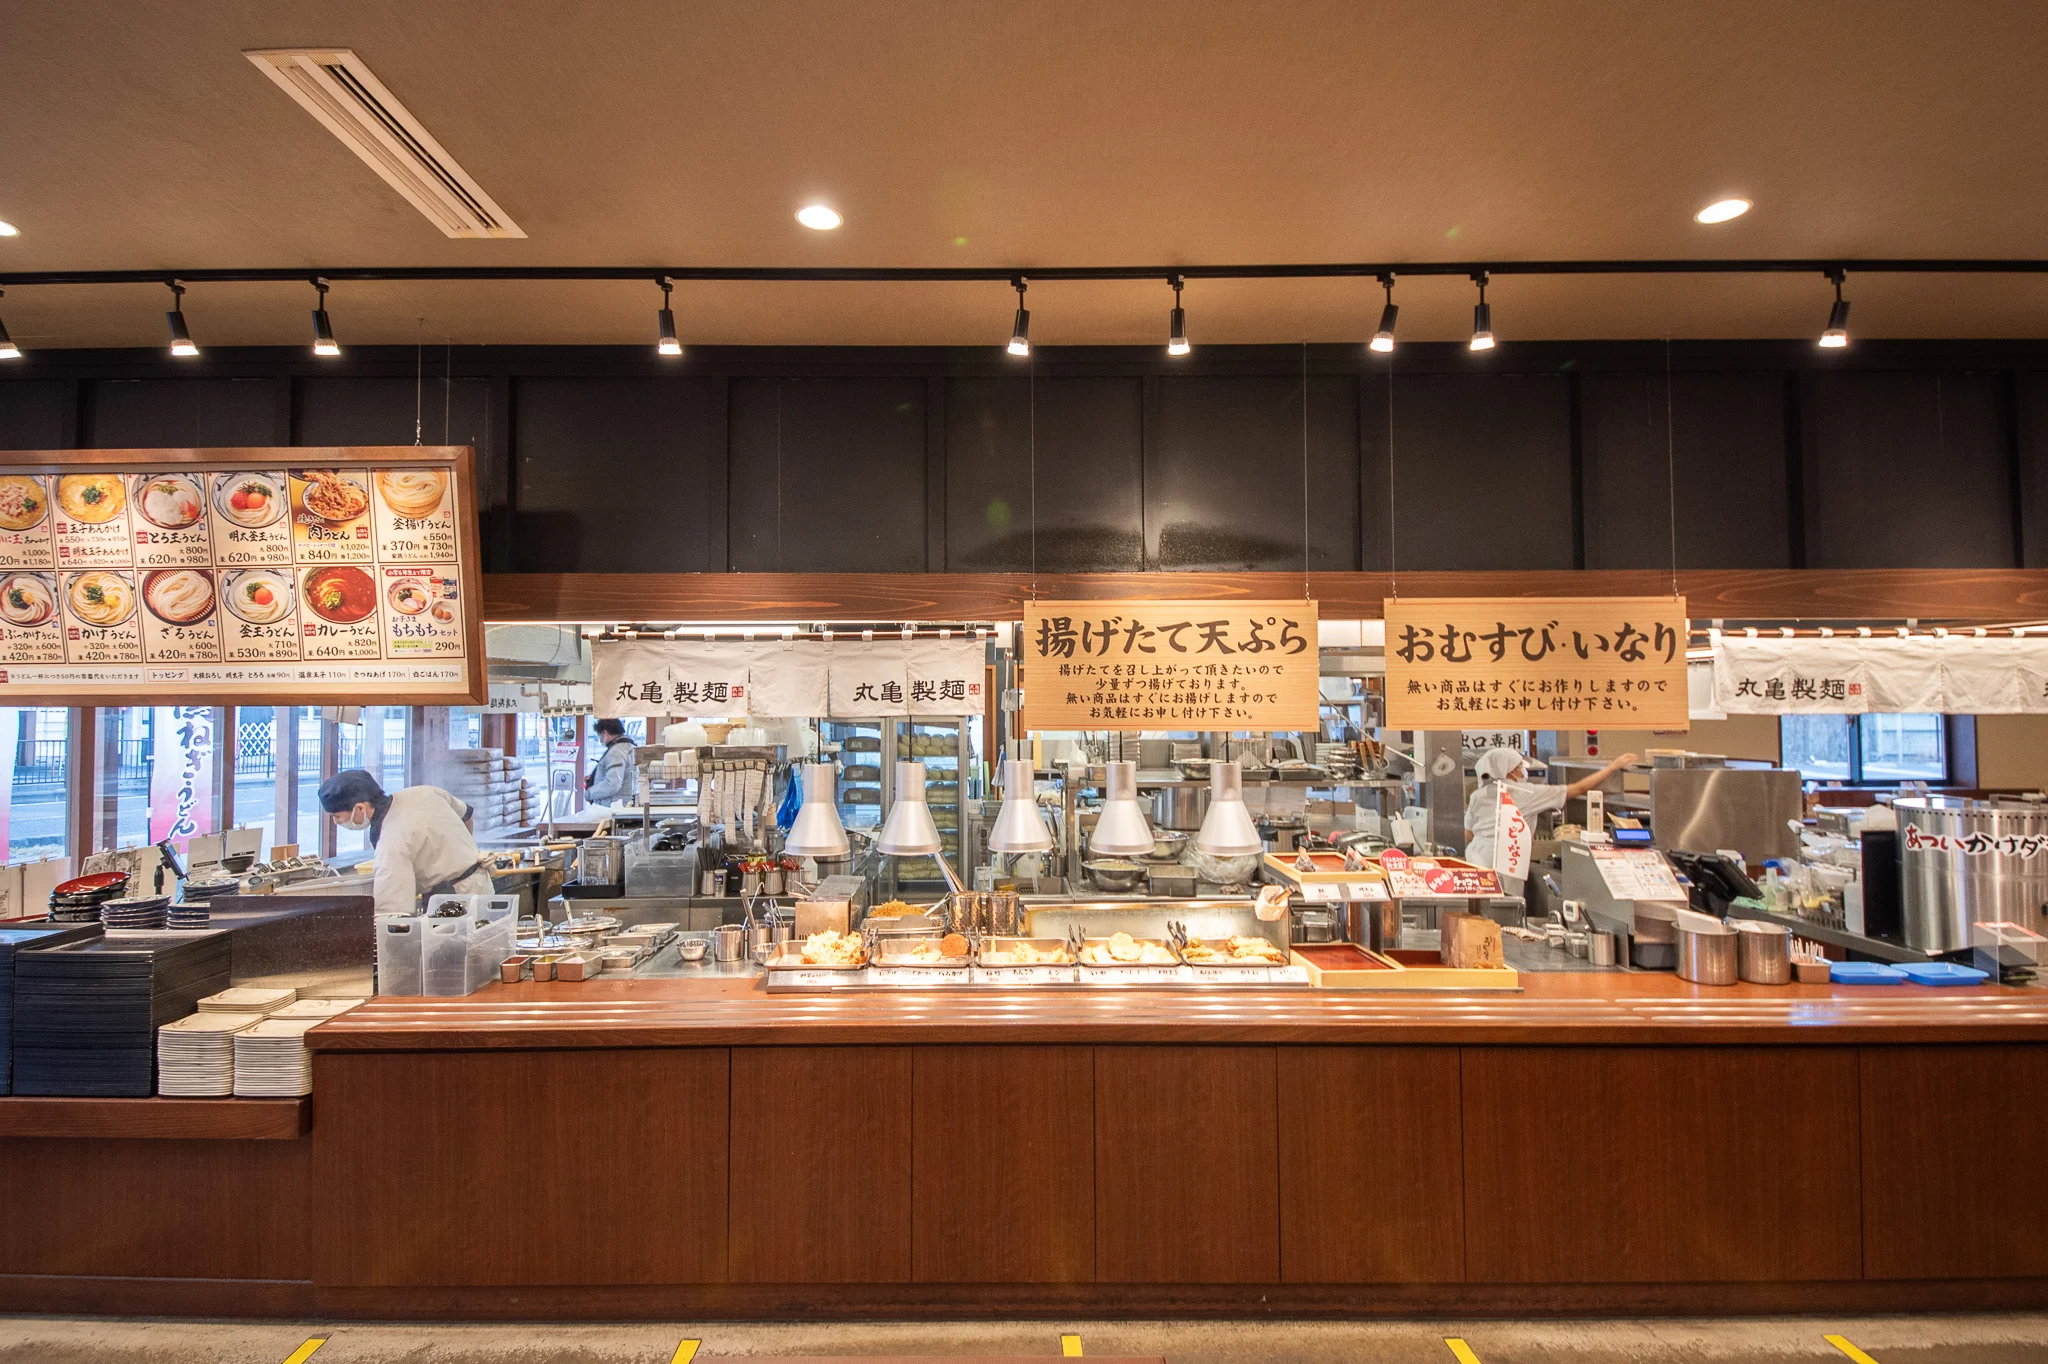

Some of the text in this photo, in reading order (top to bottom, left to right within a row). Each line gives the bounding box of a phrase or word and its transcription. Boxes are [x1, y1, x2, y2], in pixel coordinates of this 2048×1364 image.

[393, 518, 451, 531] 釜揚げうどん
[149, 531, 207, 544] とろ玉うどん
[229, 530, 287, 542] 明太釜玉うどん
[308, 525, 350, 540] 肉うどん
[390, 541, 420, 551] 370円
[149, 553, 177, 564] 620円
[228, 552, 257, 563] 620円
[308, 550, 338, 560] 840円
[5, 628, 60, 640] ぶっかけうどん
[82, 628, 137, 640] かけうどん
[160, 626, 214, 640] ざるうどん
[240, 624, 295, 639] 釜玉うどん
[317, 624, 376, 637] カレーうどん
[1035, 615, 1308, 658] 揚げたて天ぷら
[434, 641, 461, 651] 290円
[1396, 620, 1677, 664] おむすび・いなり
[158, 649, 187, 660] 420円
[237, 648, 266, 659] 530円
[316, 646, 346, 657] 640円
[152, 671, 185, 679] トッピング
[1059, 663, 1284, 677] 揚げたてを召し上がって頂きたいので
[1095, 677, 1247, 691] 少量ずつ揚げております。
[1407, 679, 1668, 694] 無い商品はすぐにお作りしますので
[1735, 677, 1846, 700] 丸亀製麺
[616, 681, 728, 704] 丸亀製麺
[853, 679, 965, 704] 丸亀製麺
[1066, 692, 1278, 705] 無い商品はすぐにお揚げしますので
[1436, 697, 1639, 712] お気軽にお申し付け下さい。
[1089, 706, 1254, 720] お気軽にお申し付け下さい。
[1906, 825, 2048, 858] あついかけダ
